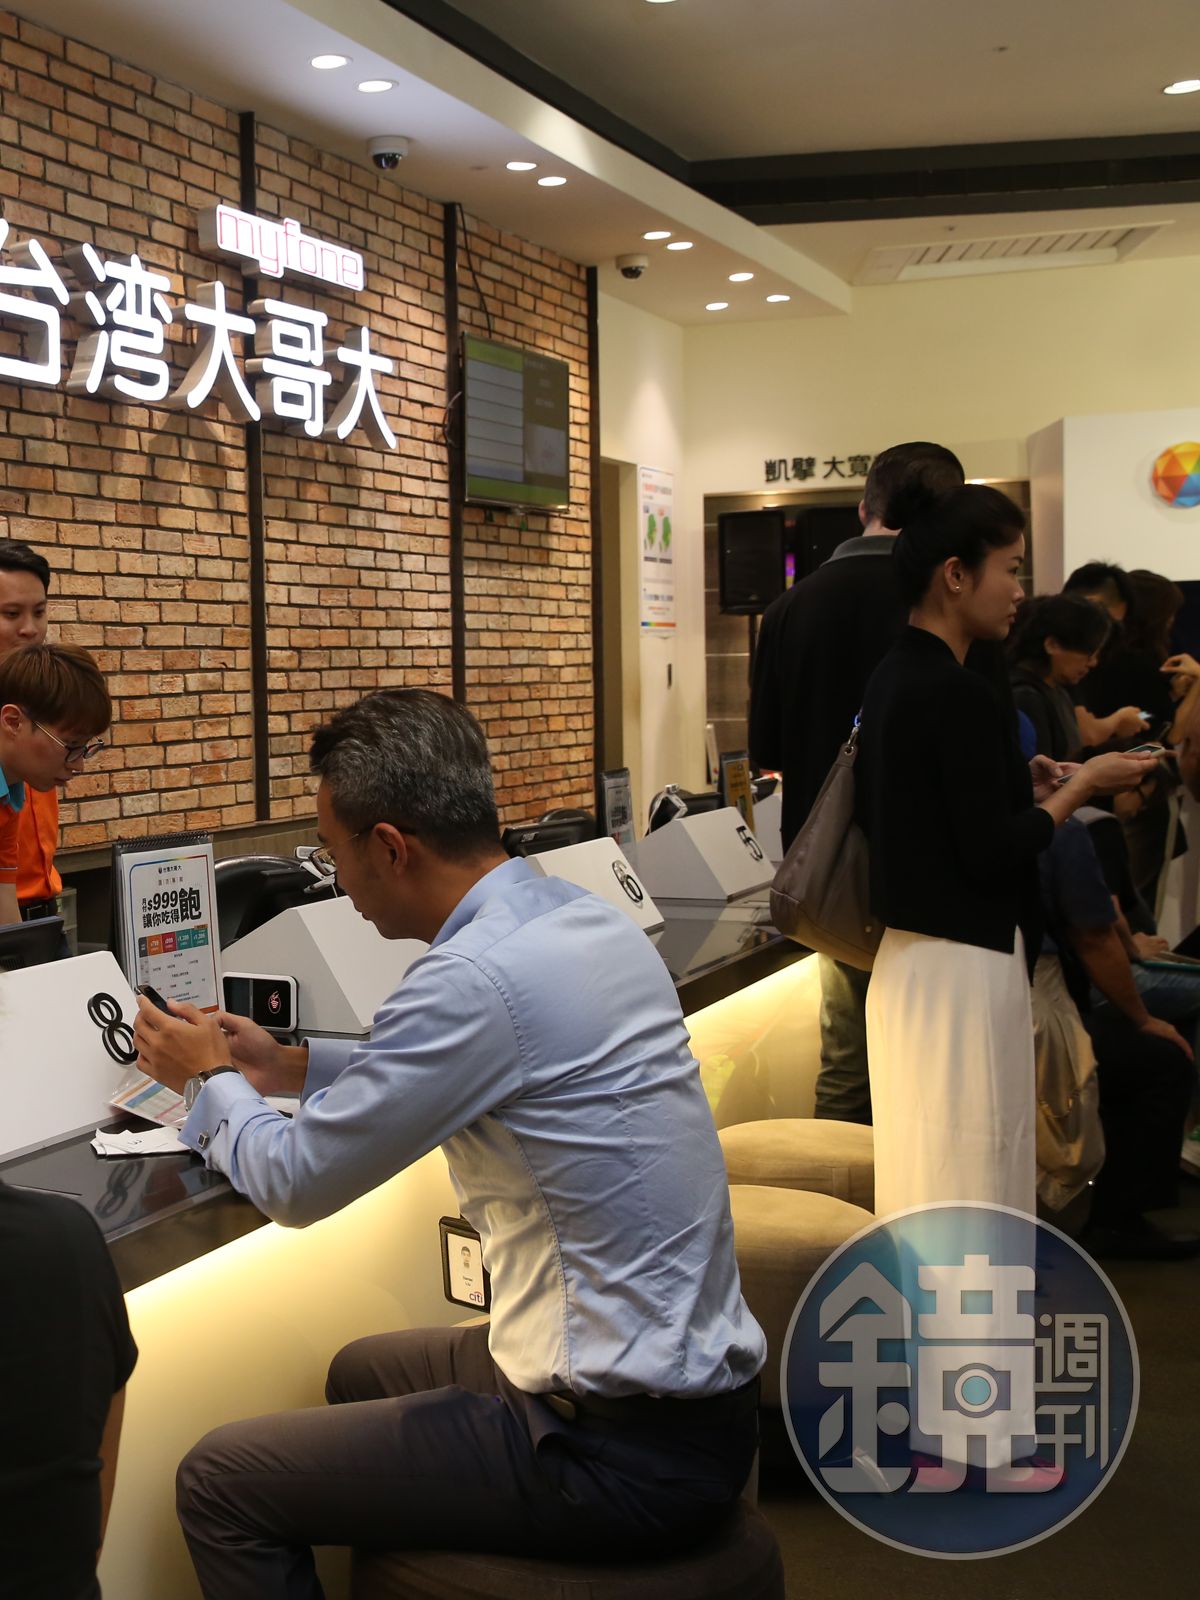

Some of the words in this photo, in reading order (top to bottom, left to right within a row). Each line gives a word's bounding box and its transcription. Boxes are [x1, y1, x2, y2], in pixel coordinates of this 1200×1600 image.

[216, 205, 365, 291] myfone
[764, 455, 879, 482] 凱擘大寬
[735, 825, 764, 862] 5
[611, 859, 644, 904] 6
[142, 908, 180, 929] 讓你吃得
[178, 886, 202, 922] 飽
[87, 992, 140, 1065] 8
[469, 1291, 484, 1304] citi
